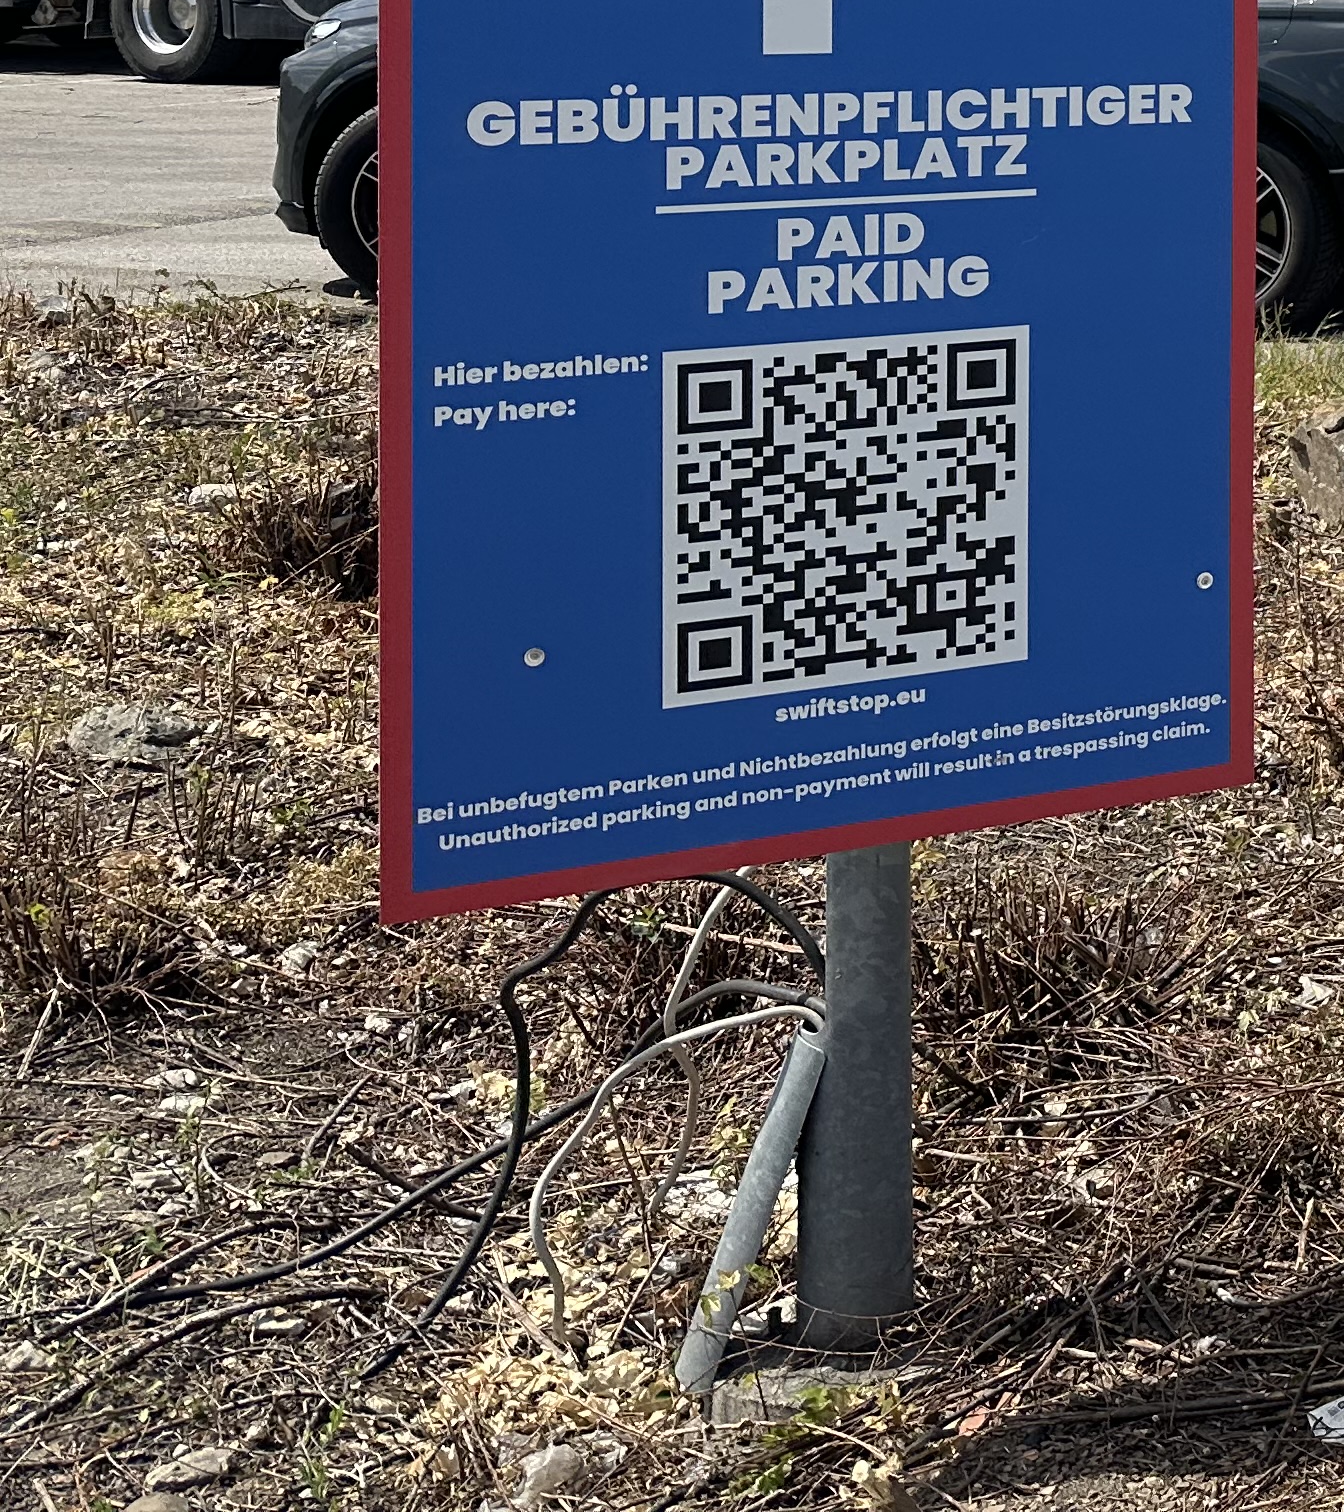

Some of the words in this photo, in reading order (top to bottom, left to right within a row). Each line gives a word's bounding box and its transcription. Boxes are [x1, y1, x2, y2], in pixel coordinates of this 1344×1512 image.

[466, 83, 1193, 147] GEBÜHRENPFLICHTIGER
[665, 133, 1028, 191] PARKPLATZ
[777, 212, 925, 261] PAID
[707, 255, 990, 315] PARKING
[434, 362, 498, 387] Hier
[503, 351, 649, 382] bezahlen:
[434, 405, 494, 431] Pay
[498, 398, 577, 422] here:
[775, 688, 926, 723] swiftstop.eu
[417, 801, 454, 825] Bei
[458, 784, 604, 818] unbefugtem
[608, 771, 688, 796] Parken
[692, 762, 735, 784] und
[739, 738, 907, 778] Nichtbezahlung
[910, 727, 978, 752] erfolgt
[981, 722, 1024, 741] eine
[1027, 693, 1228, 735] Besitzstörungsklage.
[439, 811, 598, 851] Unauthorized
[602, 800, 691, 831] parking
[695, 790, 738, 812] and
[742, 770, 891, 805] non-payment
[894, 762, 930, 781] will
[934, 753, 992, 776] result
[995, 748, 1015, 767] in
[1018, 749, 1032, 763] a
[1034, 729, 1149, 762] trespassing
[1152, 722, 1211, 744] claim.
